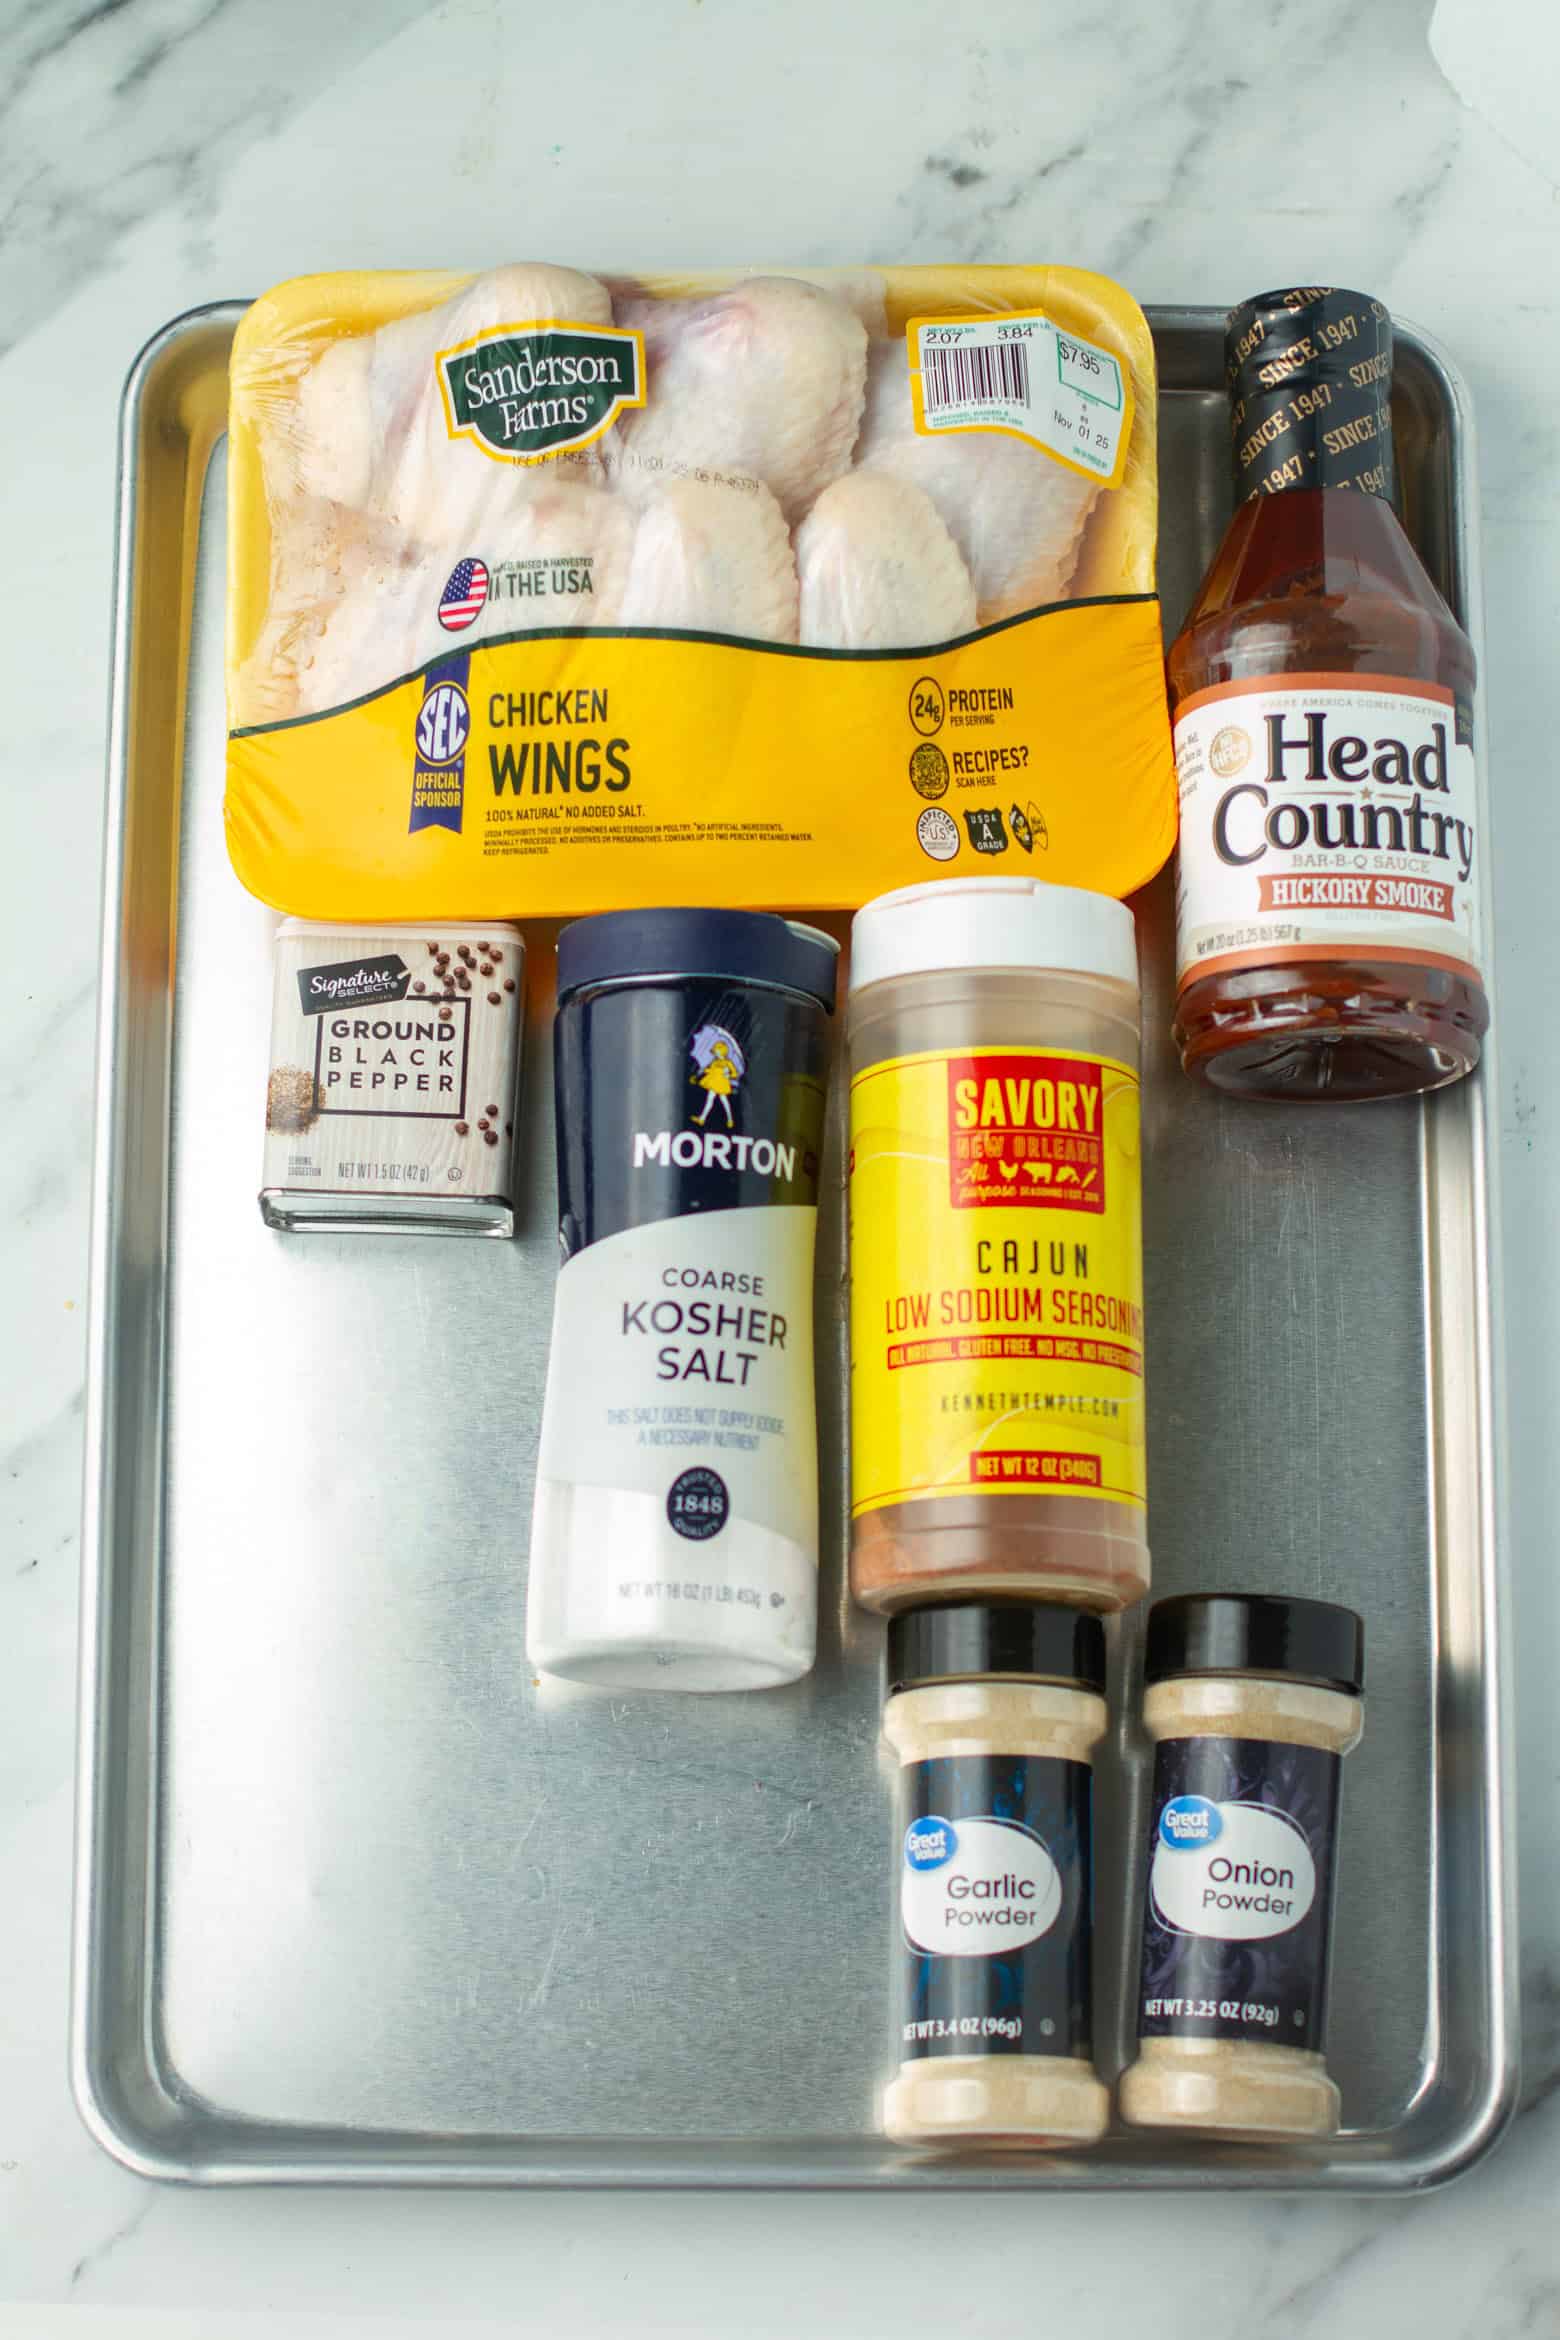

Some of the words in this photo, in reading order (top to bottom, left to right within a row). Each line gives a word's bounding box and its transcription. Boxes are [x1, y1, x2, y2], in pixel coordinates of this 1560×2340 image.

[925, 333, 962, 344] 2.07
[998, 327, 1032, 340] 3.84
[1060, 341, 1100, 375] $7.95
[1259, 337, 1319, 389] SINCE
[1317, 316, 1358, 350] 1947
[465, 347, 622, 409] Sanderson
[501, 396, 588, 440] Farms
[1241, 410, 1290, 468] SINCE
[1288, 383, 1333, 421] 1947
[1349, 352, 1388, 388] SINCE
[1054, 410, 1072, 429] Nov
[1078, 425, 1090, 440] 01
[1095, 434, 1109, 449] 25
[1262, 454, 1303, 493] 1947
[1322, 415, 1376, 455] SINCE
[1356, 465, 1385, 493] 1947
[516, 559, 541, 570] RAISED
[550, 557, 593, 568] HARVESTED
[505, 570, 547, 598] THE
[552, 568, 593, 595] USA
[489, 688, 608, 728] CHICKEN
[915, 694, 940, 722] 24g
[949, 687, 1014, 712] PROTEIN
[1302, 697, 1353, 707] AMERICA
[416, 686, 467, 760] SEC
[950, 716, 964, 727] PER
[966, 714, 995, 727] SERVING
[953, 746, 1029, 774] RECIPES?
[1264, 712, 1450, 794] Head
[488, 738, 631, 796] WINGS
[416, 771, 461, 790] OFFICIAL
[956, 776, 976, 789] SCAN
[977, 775, 996, 788] HERE
[414, 790, 461, 808] SPONSOR
[485, 809, 513, 823] 100%
[566, 806, 580, 818] NO
[581, 805, 615, 818] ADDED
[617, 804, 646, 818] SALT.
[919, 810, 955, 833] INSPECTED
[976, 839, 1004, 850] GRADE
[983, 823, 994, 841] A
[1212, 783, 1473, 882] Country
[1291, 853, 1369, 868] BAR-B-Q
[1374, 855, 1431, 873] SAUCE
[1271, 879, 1372, 906] HICKORY
[1375, 880, 1445, 912] SMOKE
[310, 969, 392, 999] Signature
[337, 982, 389, 997] SELECT
[330, 1020, 456, 1042] GROUND
[329, 1046, 454, 1067] BLACK
[327, 1071, 454, 1092] PEPPER
[955, 1078, 1099, 1133] SAVORY
[633, 1131, 796, 1182] MORTON
[956, 1133, 1005, 1160] NEW
[1013, 1135, 1099, 1165] ORLEANS
[338, 1162, 355, 1178] NET
[358, 1163, 371, 1179] WT
[389, 1164, 401, 1180] OZ
[977, 1240, 1088, 1278] CAJUN
[662, 1267, 764, 1296] COARSE
[886, 1293, 930, 1334] LOW
[941, 1288, 1042, 1325] SODIUM
[621, 1300, 787, 1349] KOSHER
[657, 1347, 758, 1387] SALT
[941, 1392, 1119, 1418] KENNETHTEMPLE.COM
[975, 1456, 999, 1477] NET
[1002, 1456, 1022, 1476] WT
[1024, 1456, 1039, 1476] 12
[1041, 1456, 1058, 1478] OZ
[675, 1471, 723, 1494] TRUSTED
[674, 1494, 724, 1514] 1848
[674, 1516, 720, 1536] QUALITY
[1165, 1810, 1209, 1830] Great
[1174, 1826, 1209, 1839] Value
[908, 1830, 946, 1850] Great
[914, 1847, 946, 1861] Value
[1208, 1857, 1294, 1889] Onion
[947, 1874, 1036, 1899] Garlic
[1202, 1889, 1294, 1916] Powder
[945, 1907, 1037, 1927] Powder
[1145, 1999, 1161, 2016] NET
[1161, 1998, 1184, 2016] WT
[1185, 2000, 1217, 2018] 3.25
[1219, 2001, 1240, 2018] OZ
[1241, 2003, 1279, 2026] (92g)
[918, 2021, 935, 2039] WT
[936, 2020, 957, 2037] 3.4
[960, 2018, 980, 2036] OZ
[982, 2017, 1022, 2038] (96g)
